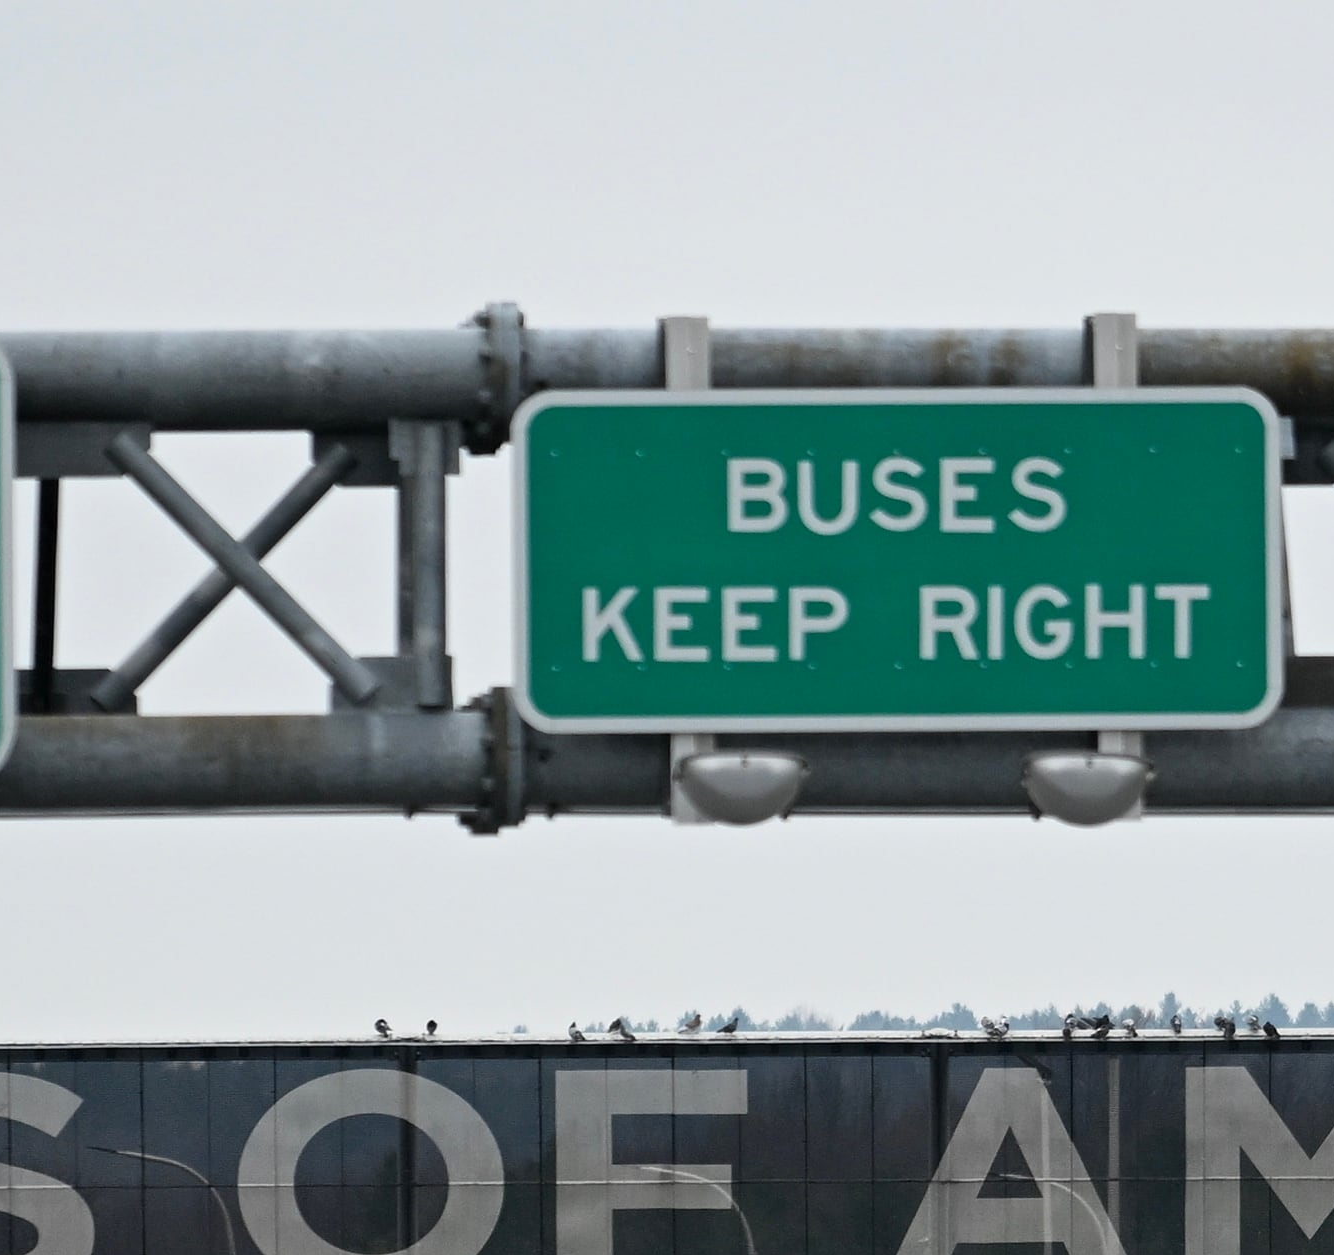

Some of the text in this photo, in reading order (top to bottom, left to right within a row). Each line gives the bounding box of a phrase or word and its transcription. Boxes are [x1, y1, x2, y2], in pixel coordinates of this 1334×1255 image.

[726, 456, 1066, 536] BUSES
[581, 583, 1212, 663] KEEP RIGHT
